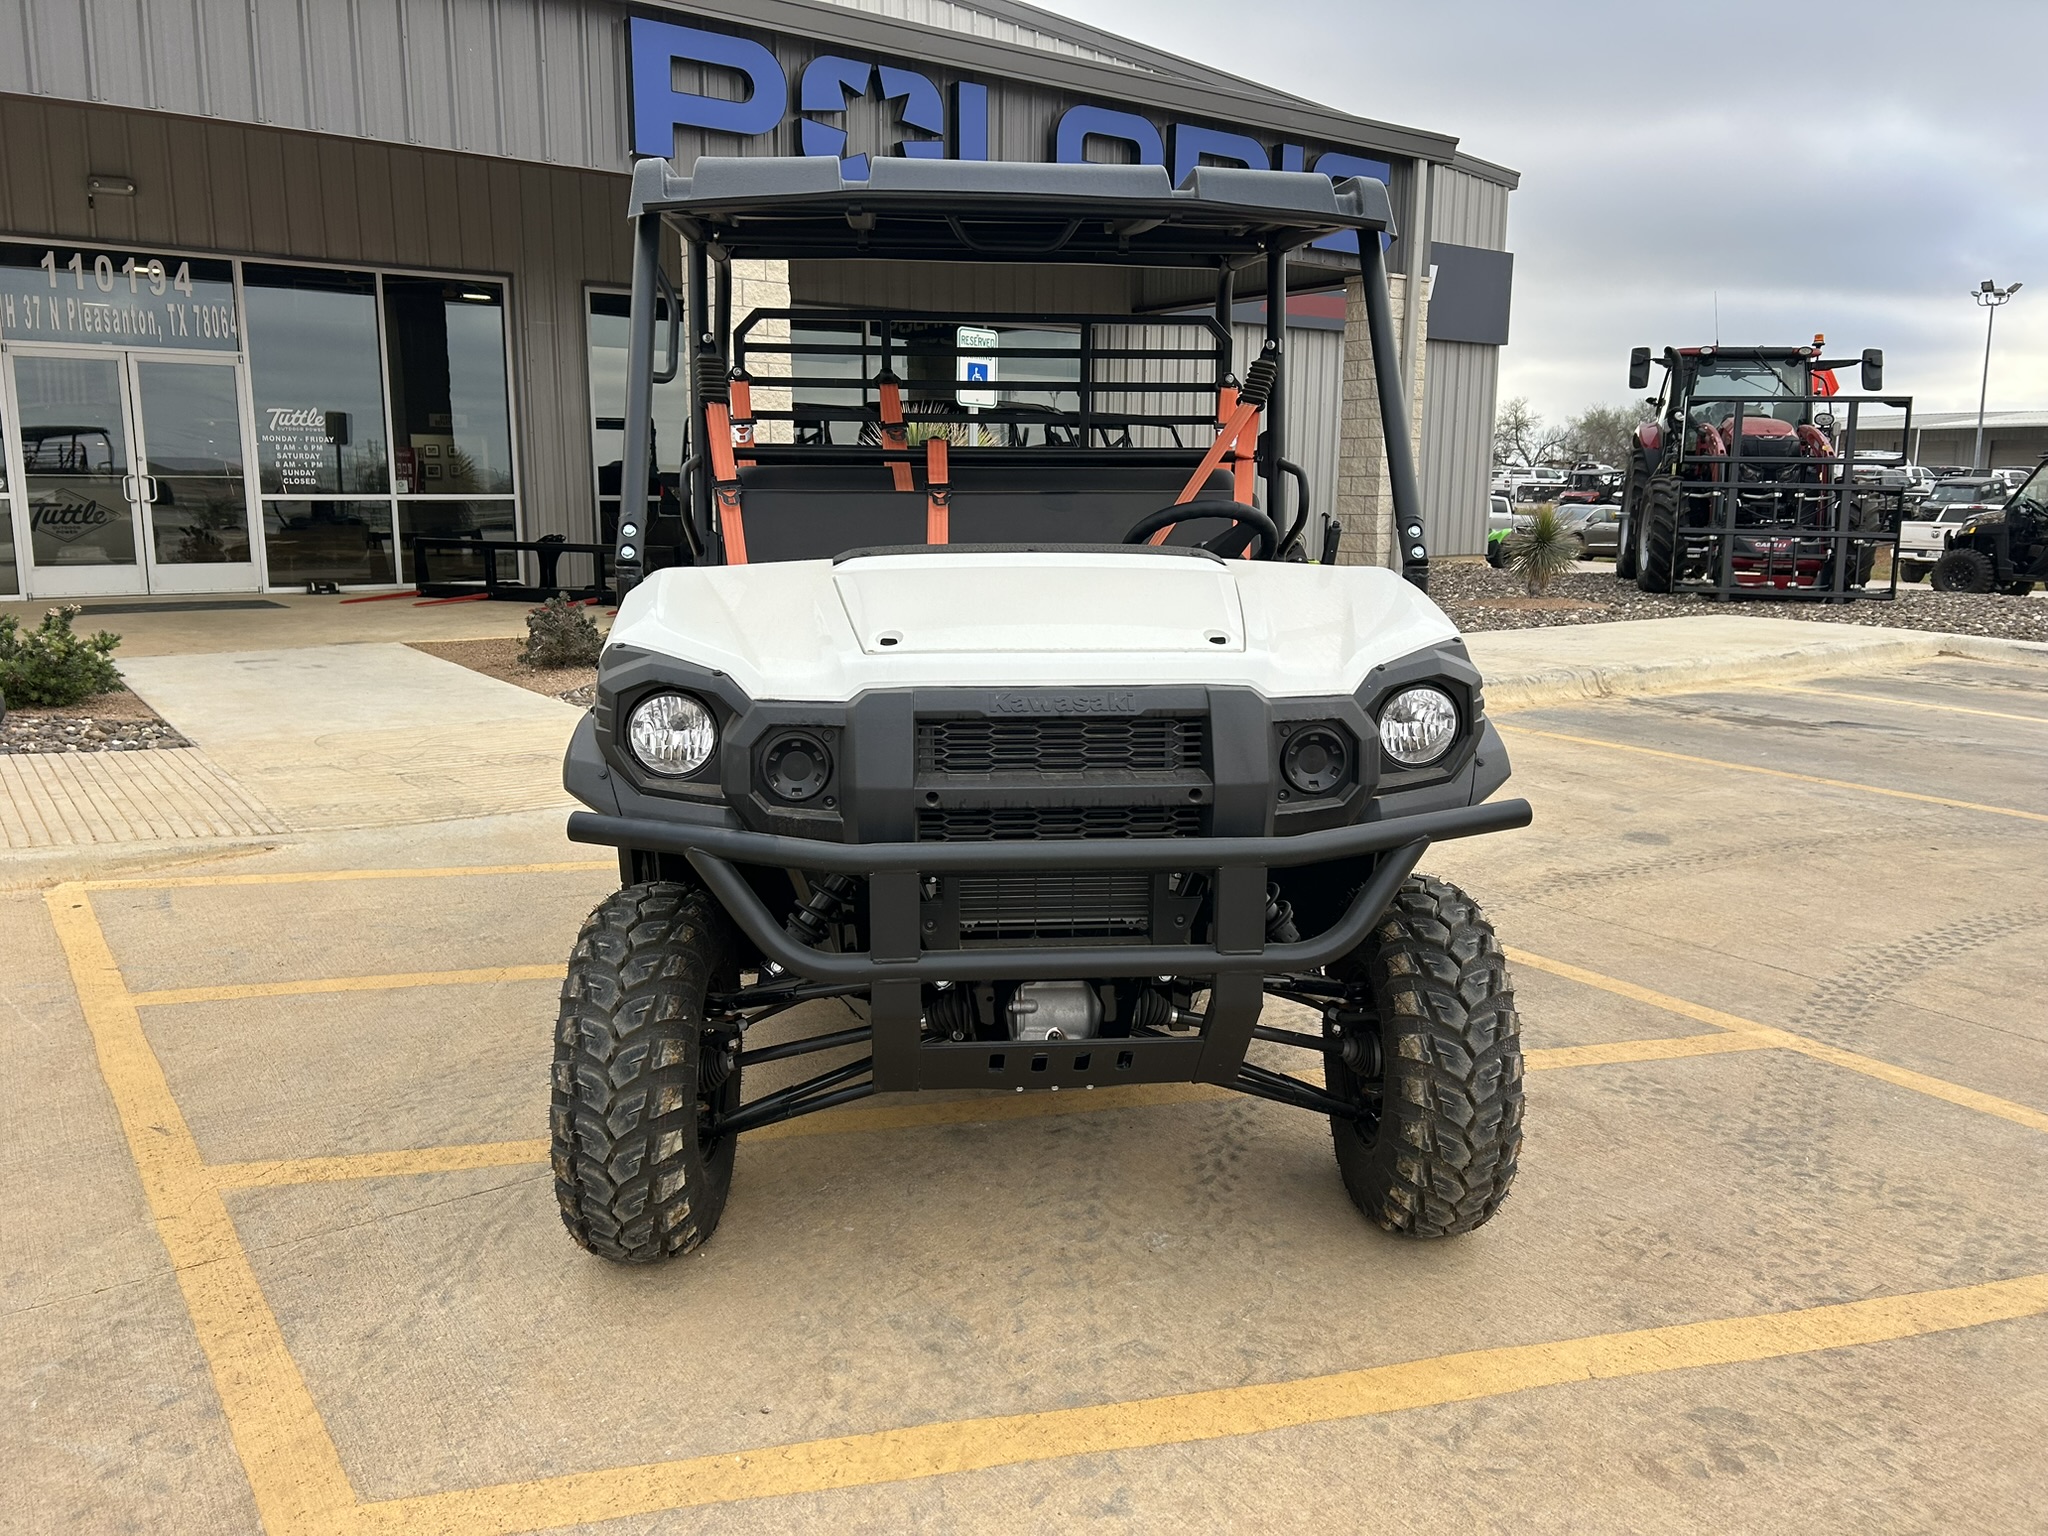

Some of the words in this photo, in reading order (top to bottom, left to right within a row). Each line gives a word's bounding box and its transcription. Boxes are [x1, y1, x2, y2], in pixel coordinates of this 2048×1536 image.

[628, 17, 1391, 255] POAS
[41, 251, 193, 297] 110194
[23, 294, 40, 329] 37
[49, 296, 60, 330] N
[67, 298, 162, 342] Pleasanton,
[167, 304, 188, 337] TX
[192, 305, 238, 338] 78064
[961, 334, 995, 348] RESERVED
[266, 407, 325, 431] Tuttle
[283, 477, 316, 485] CLOSED
[29, 500, 107, 532] Tuttle
[988, 692, 1135, 713] Kawasaki
